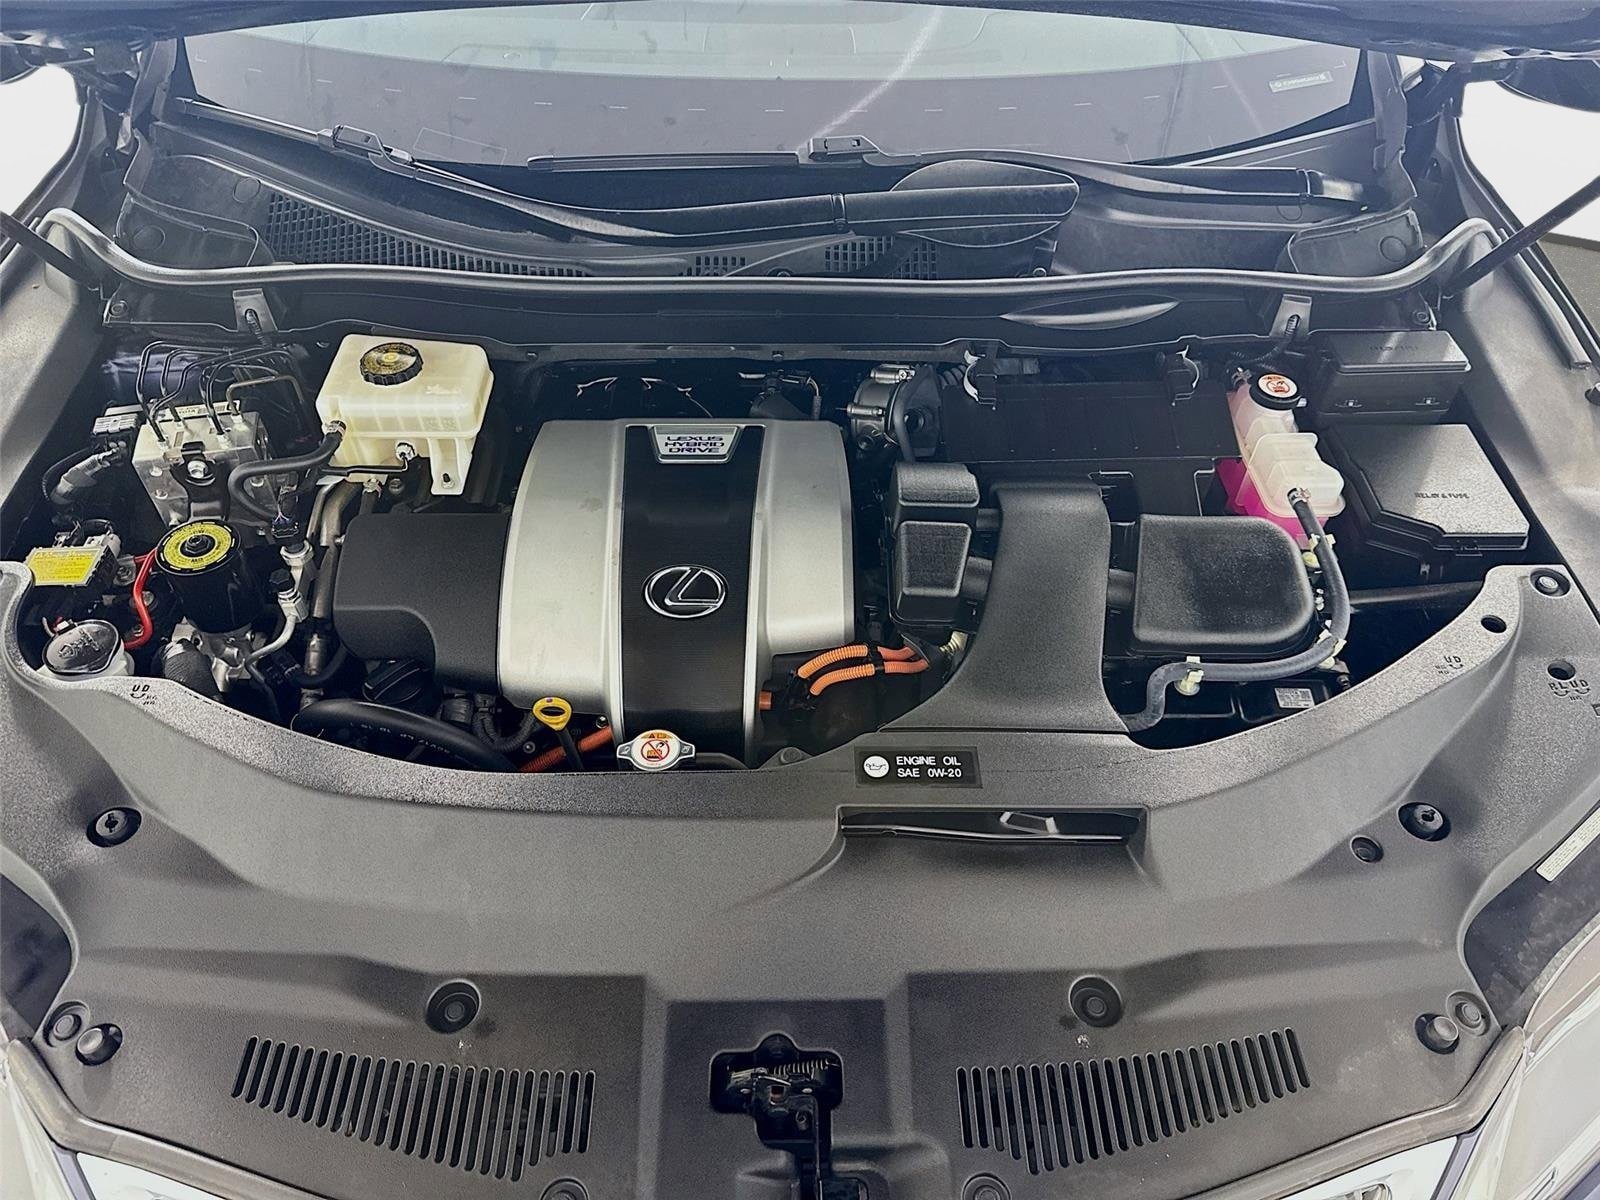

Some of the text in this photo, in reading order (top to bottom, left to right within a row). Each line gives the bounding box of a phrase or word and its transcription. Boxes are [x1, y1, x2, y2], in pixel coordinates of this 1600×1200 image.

[895, 755, 962, 766] ENGINE OIL
[897, 767, 962, 778] SAE 0W-20
